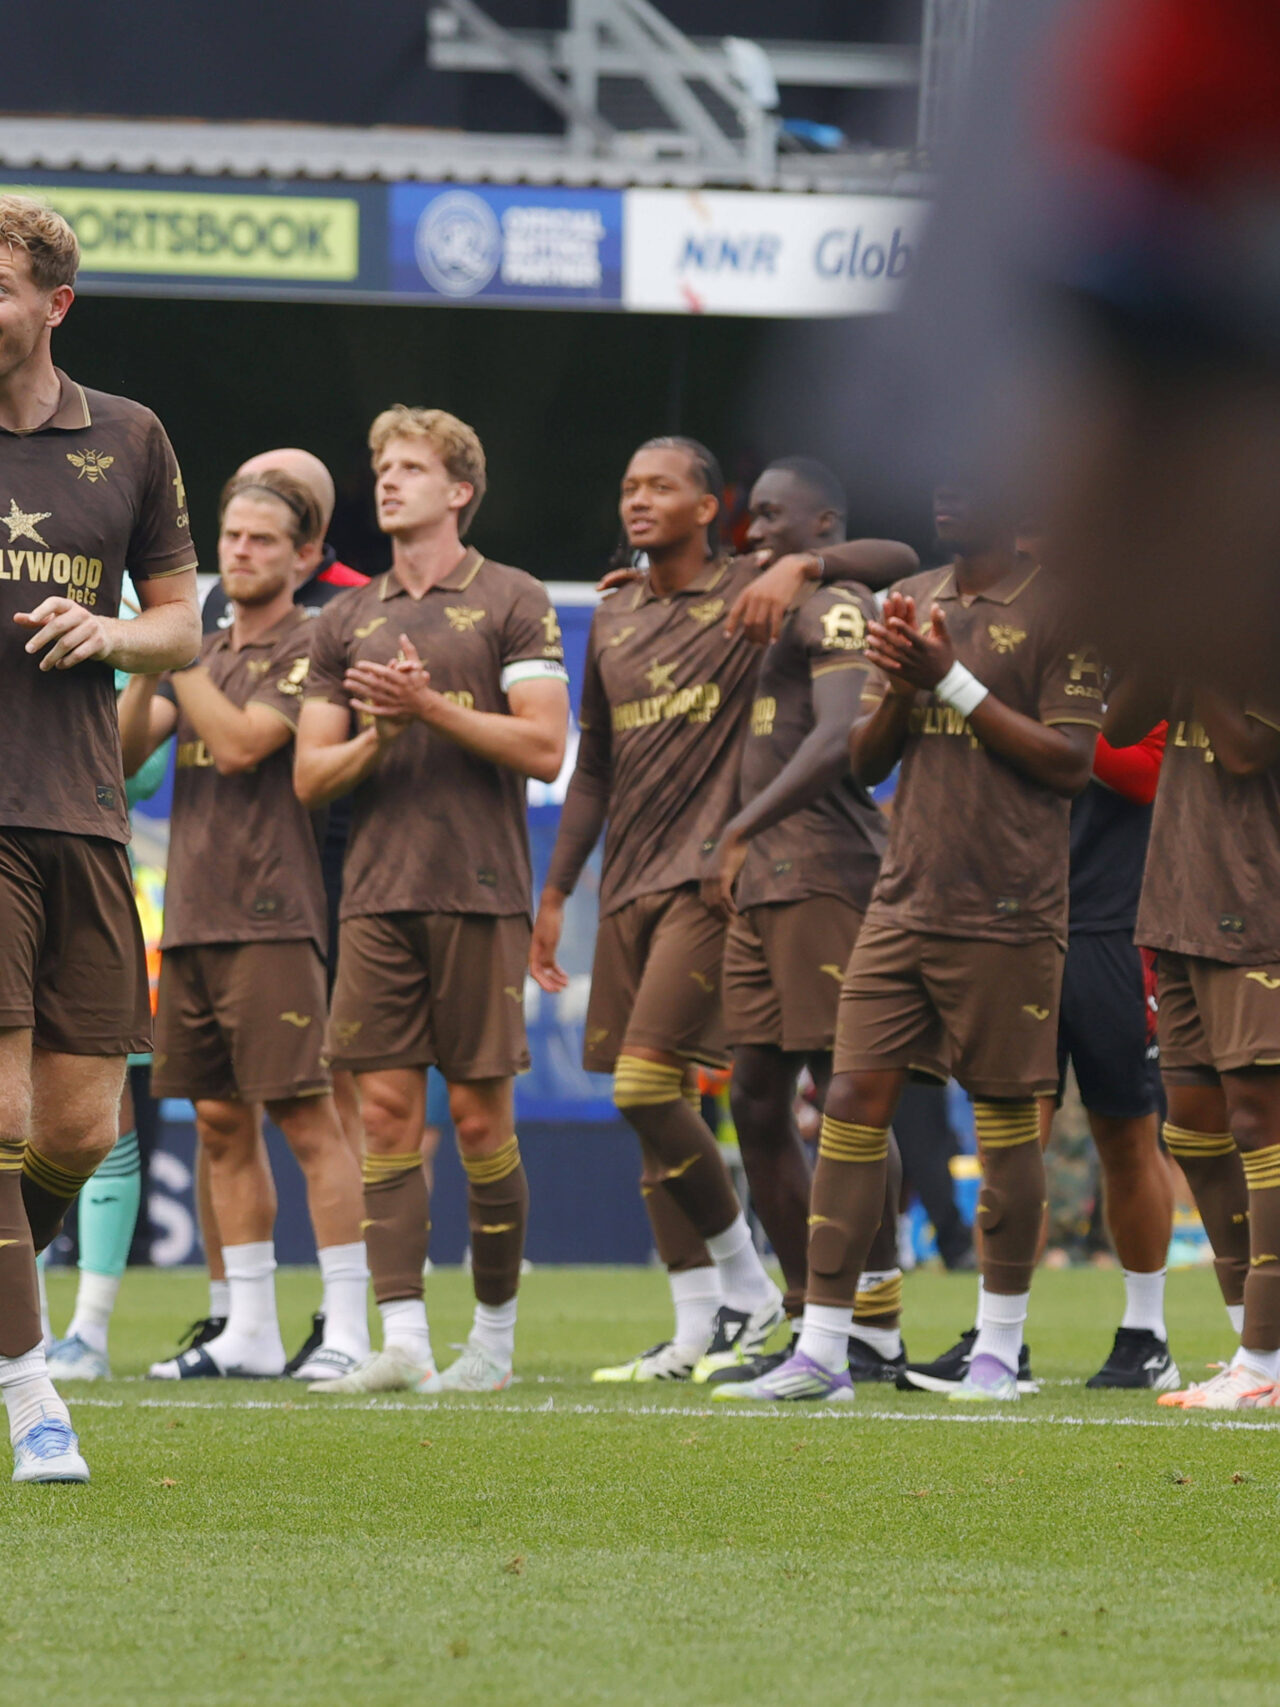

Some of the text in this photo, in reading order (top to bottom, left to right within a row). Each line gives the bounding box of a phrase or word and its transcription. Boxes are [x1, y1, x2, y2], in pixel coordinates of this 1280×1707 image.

[58, 203, 333, 259] ORTSBOOK
[674, 232, 784, 275] NNR
[67, 583, 97, 606] bets
